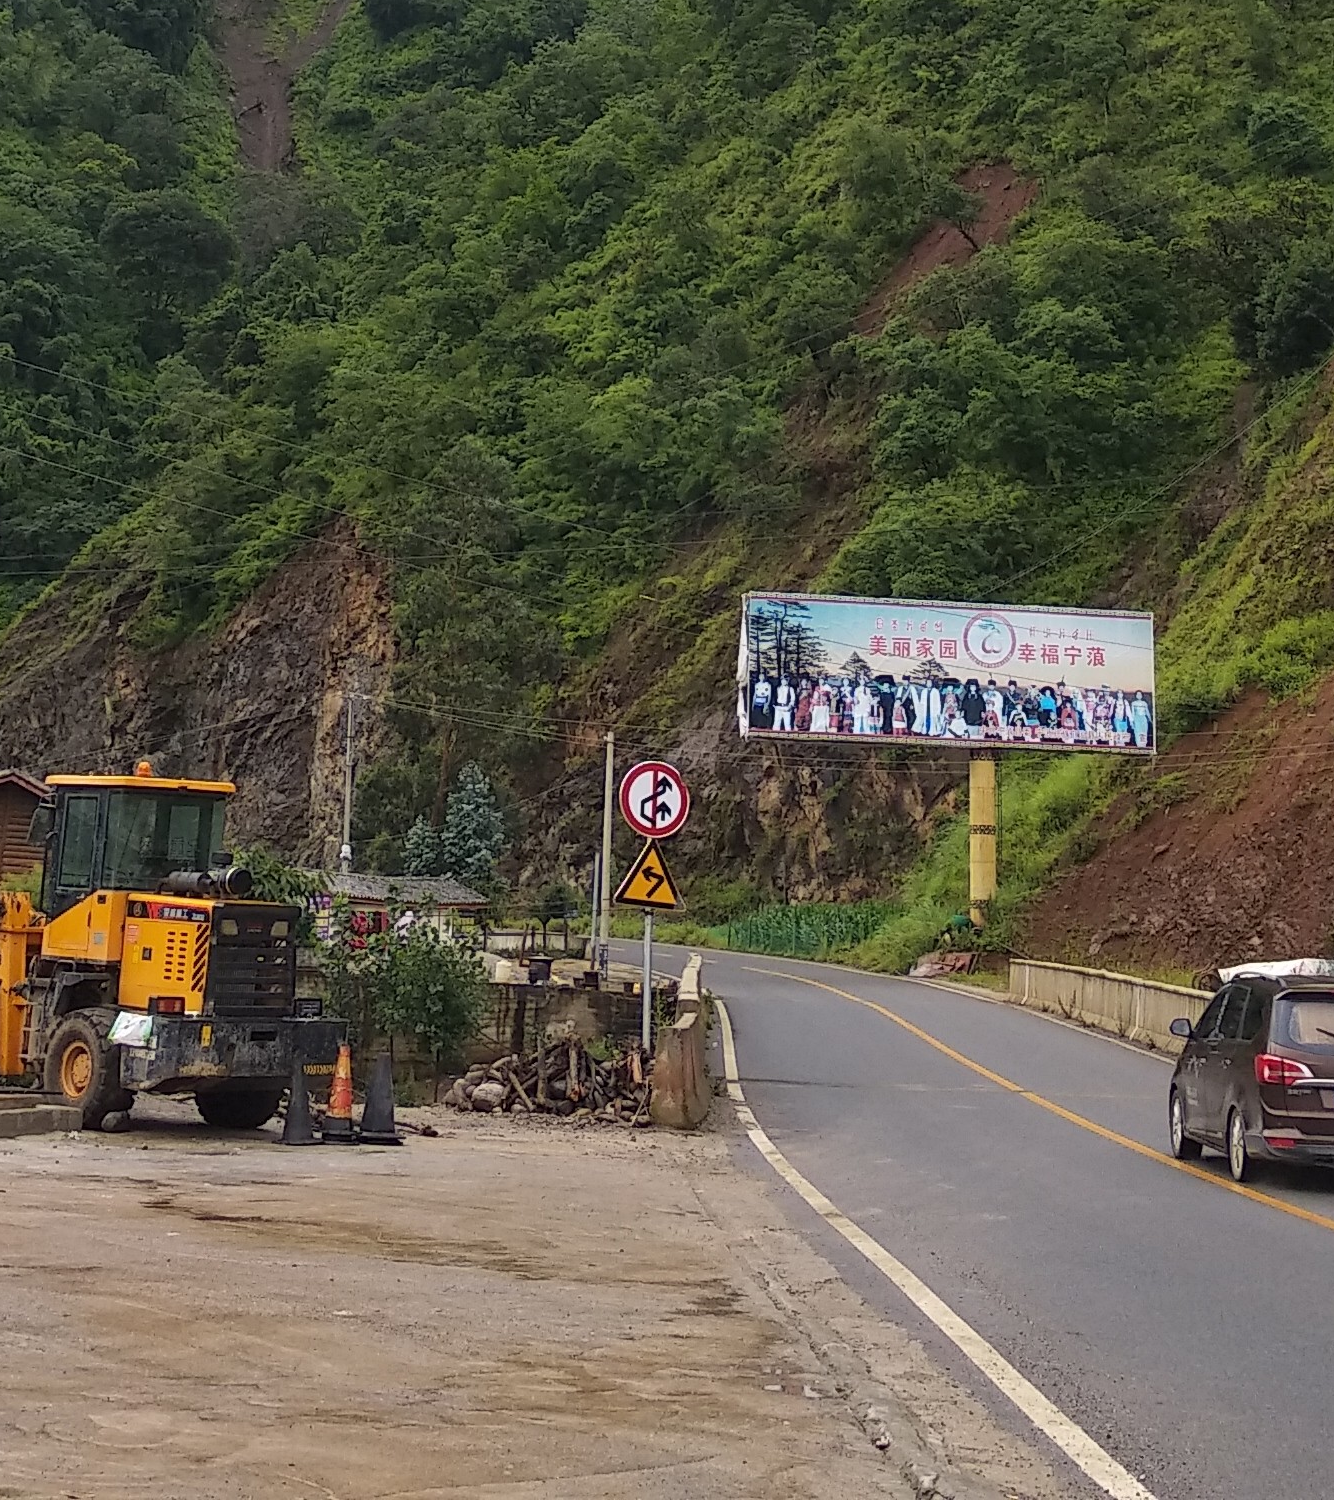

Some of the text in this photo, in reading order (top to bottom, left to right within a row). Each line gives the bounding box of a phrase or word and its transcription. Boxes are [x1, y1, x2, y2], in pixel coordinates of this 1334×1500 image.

[869, 635, 957, 659] 美丽家园
[1018, 643, 1105, 666] 幸福宁蒗
